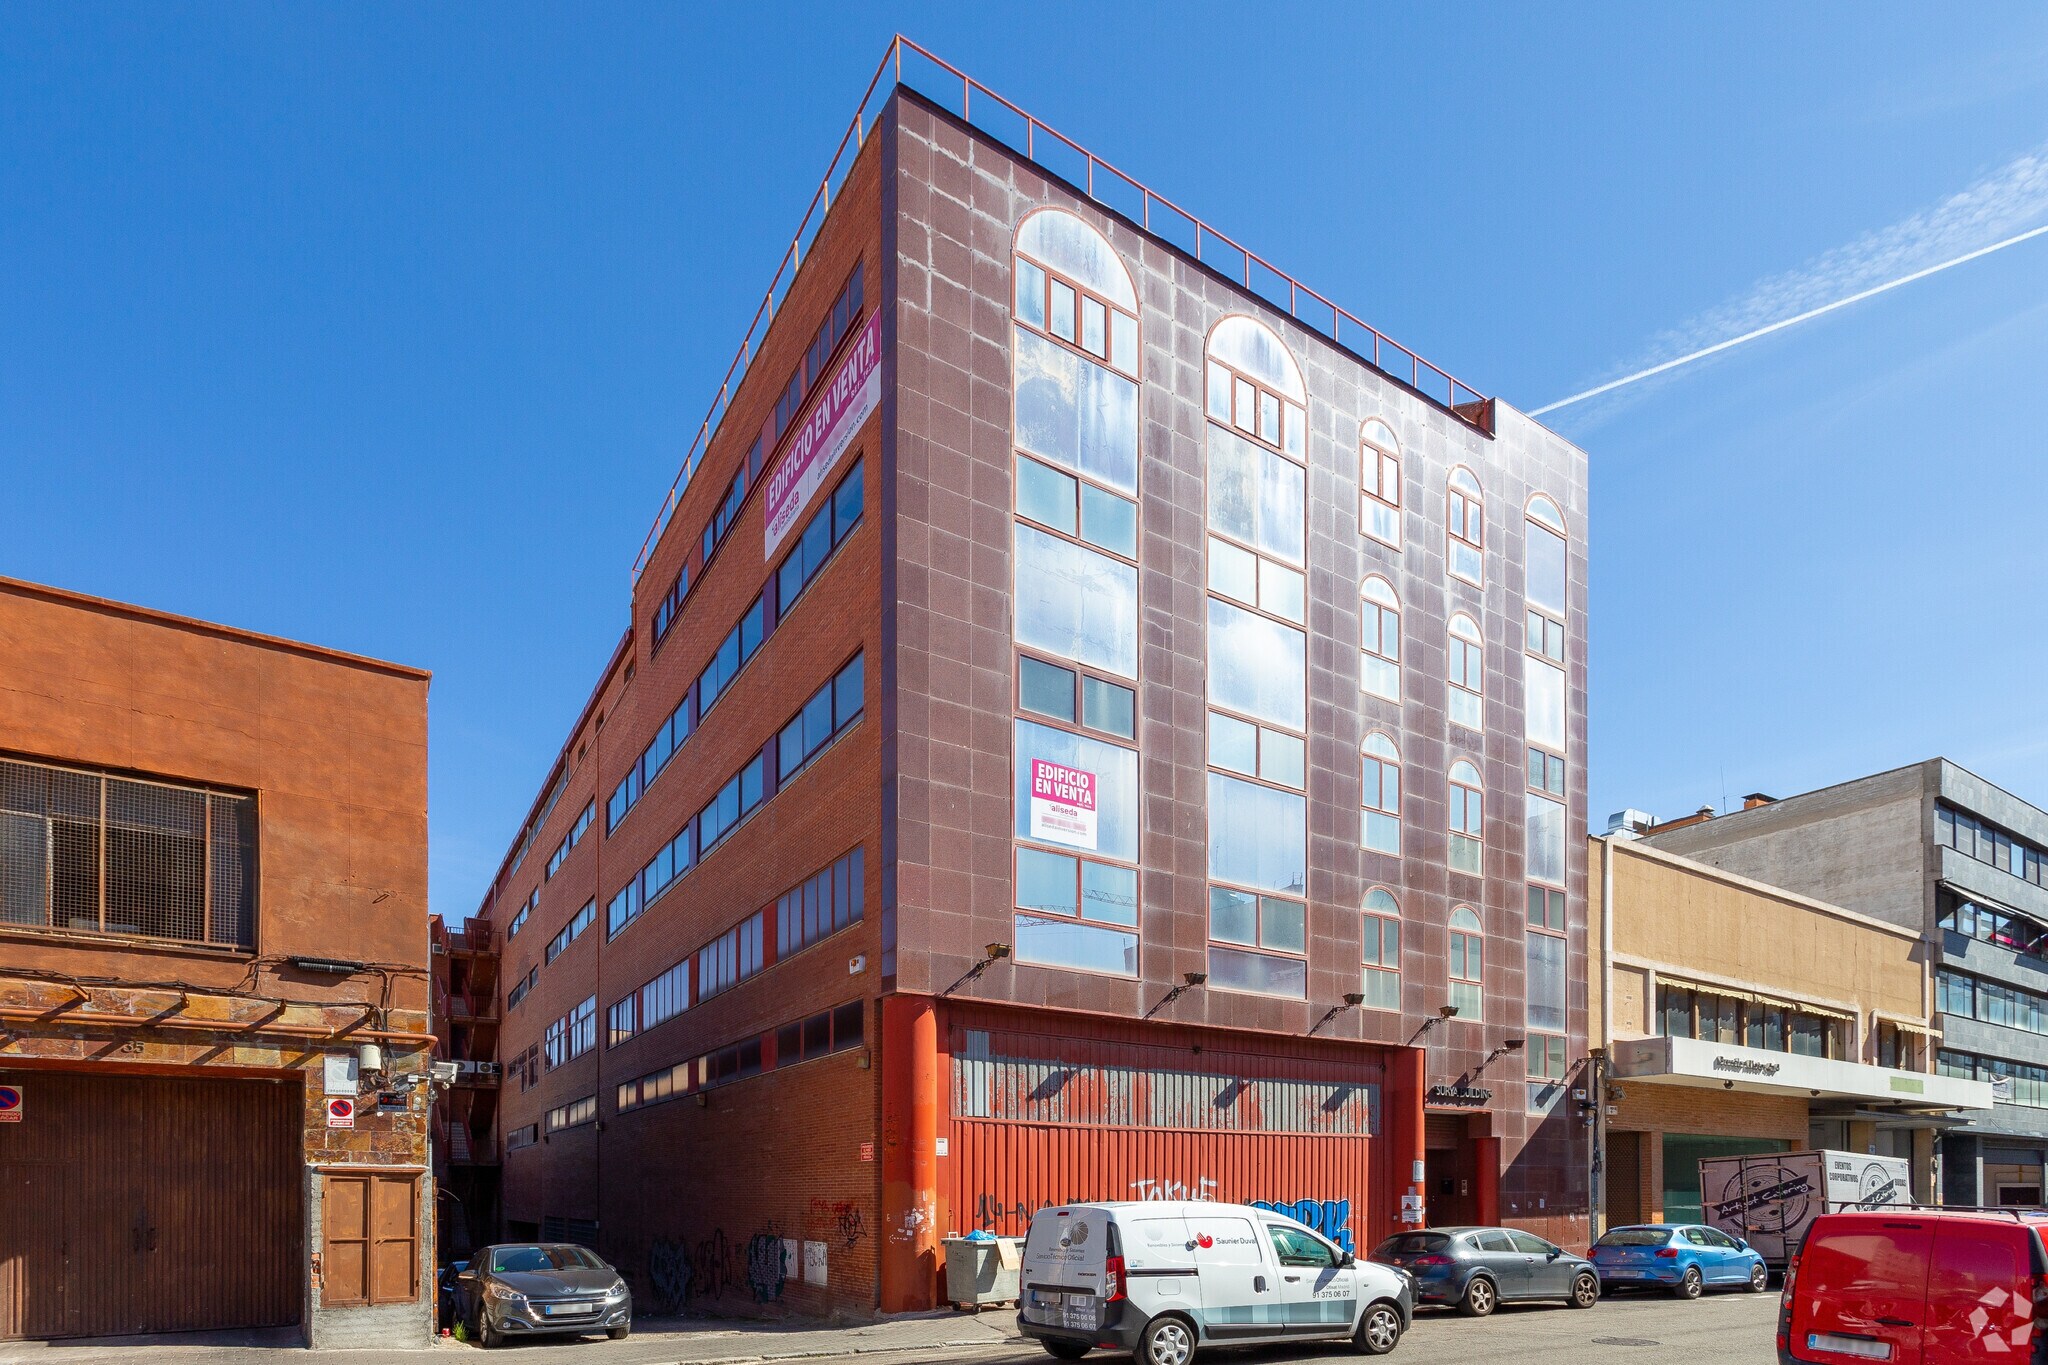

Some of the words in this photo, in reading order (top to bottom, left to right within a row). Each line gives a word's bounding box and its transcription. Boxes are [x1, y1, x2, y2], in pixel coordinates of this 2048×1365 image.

[769, 424, 813, 512] EDIFICIO
[815, 394, 830, 441] EN
[833, 327, 875, 411] VENTA
[772, 491, 799, 536] aliseda
[1038, 763, 1089, 789] EDIFICIO
[1035, 778, 1051, 795] EN
[1054, 782, 1092, 804] VENTA
[1050, 805, 1077, 816] aliseda
[1436, 1085, 1459, 1097] SURYA
[1834, 1161, 1852, 1171] EVENTOS
[1829, 1172, 1858, 1182] CORPORATIVOS
[1216, 1237, 1239, 1245] Saunier
